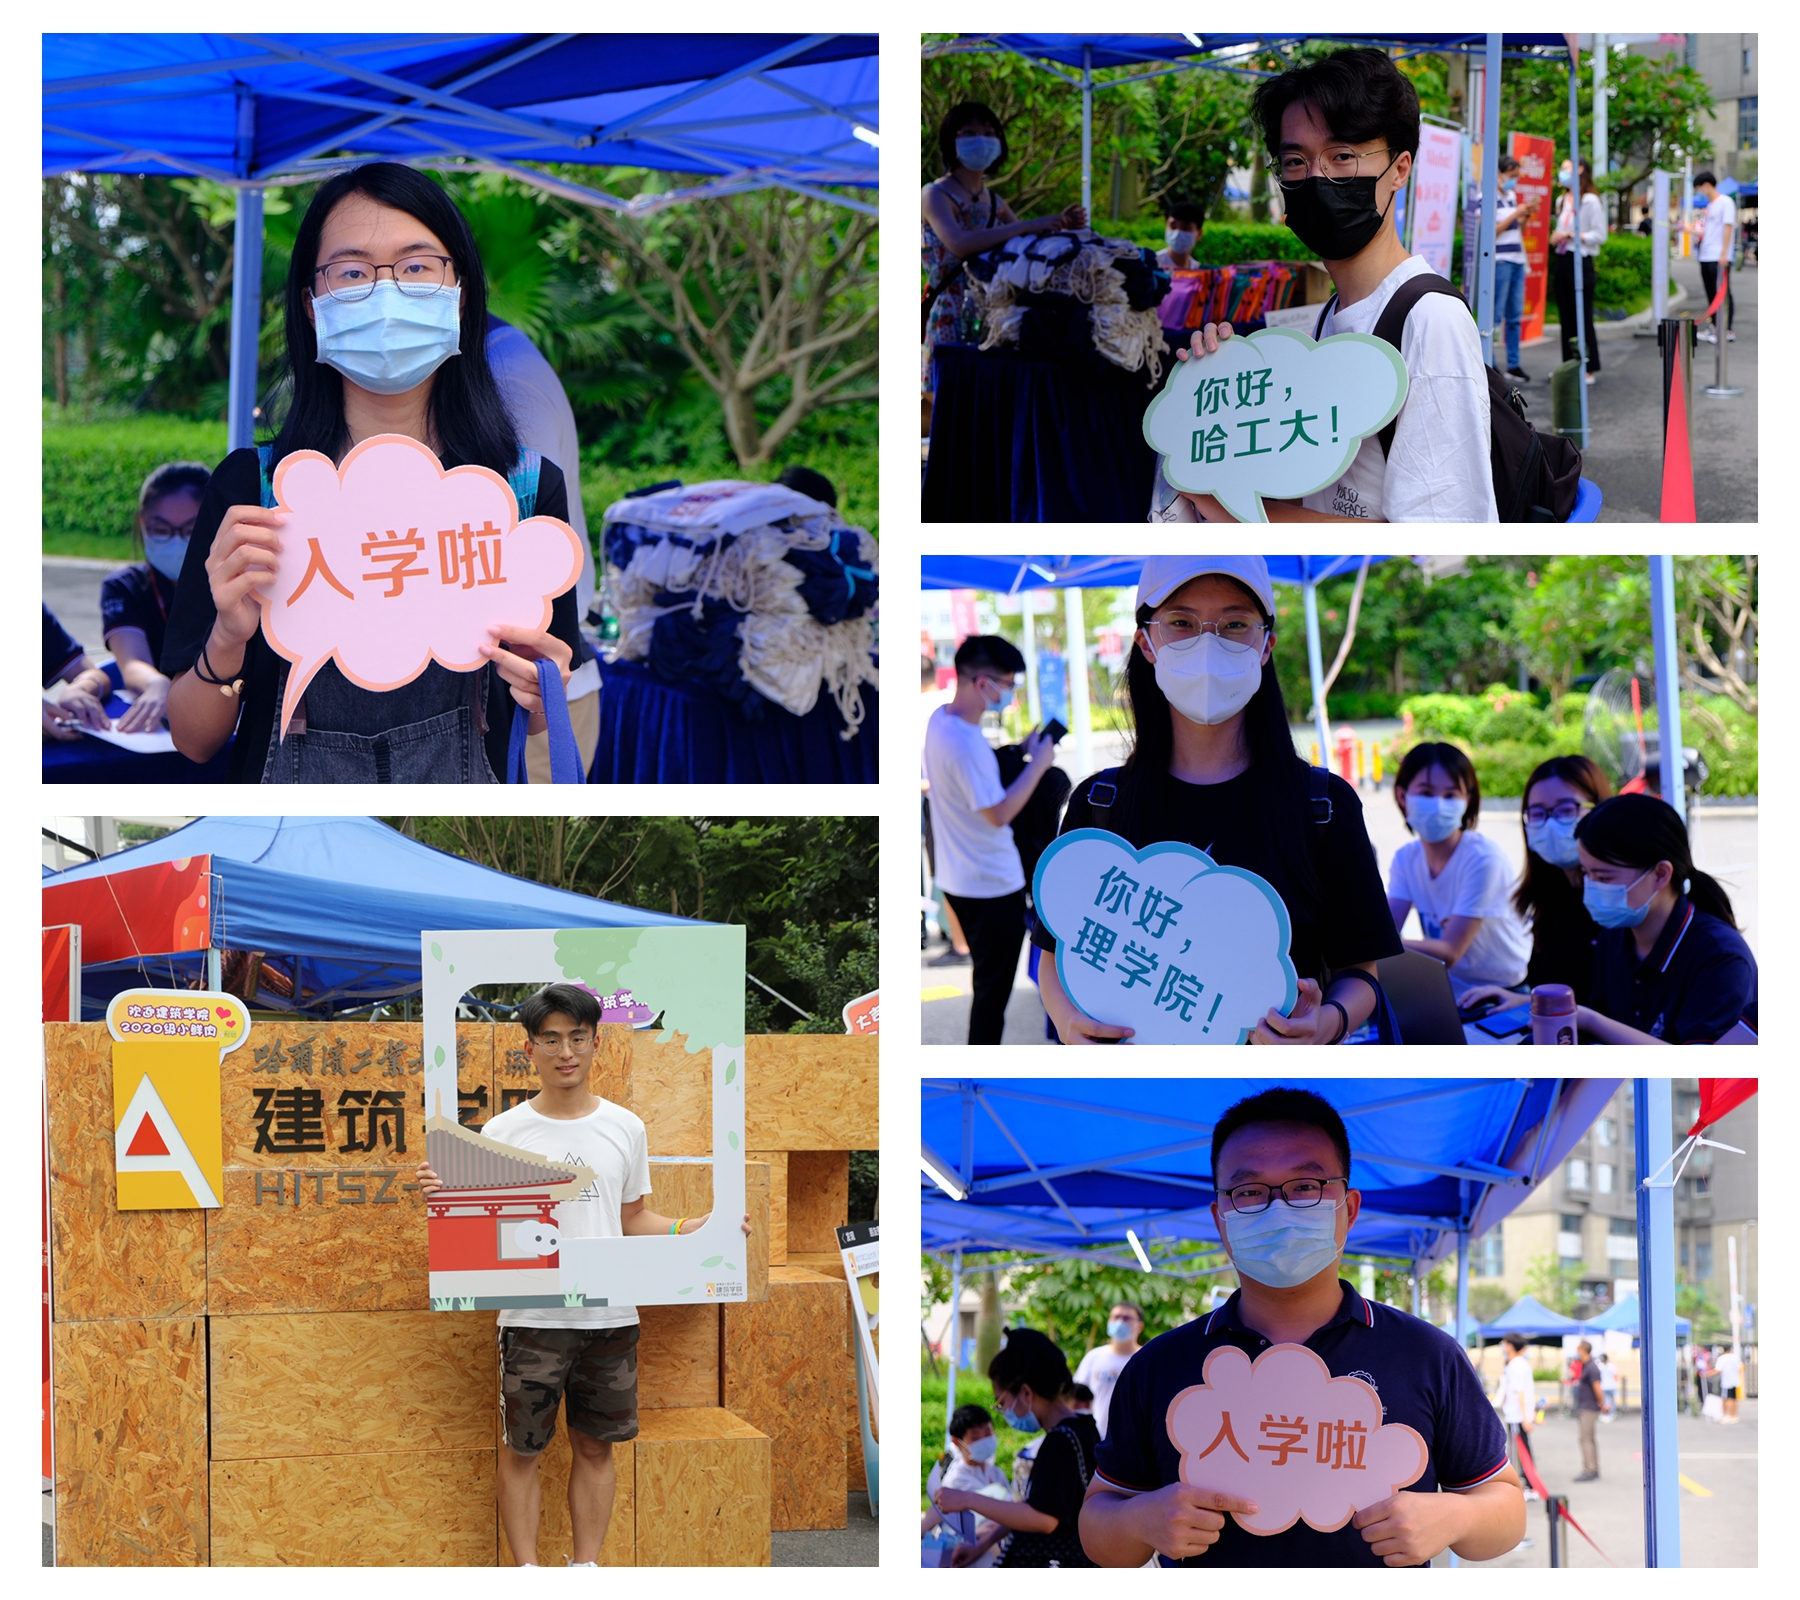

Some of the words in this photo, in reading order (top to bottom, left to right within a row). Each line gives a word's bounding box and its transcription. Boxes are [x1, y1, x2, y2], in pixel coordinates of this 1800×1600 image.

[1193, 367, 1293, 417] 你好，
[1190, 405, 1339, 464] 哈工大！
[286, 520, 508, 608] 入学啦
[1094, 865, 1192, 954] 你好，
[1070, 916, 1223, 1034] 理学院！
[120, 1021, 218, 1038] 2020级小鲜肉
[127, 1004, 210, 1021] 欢迎建筑学院
